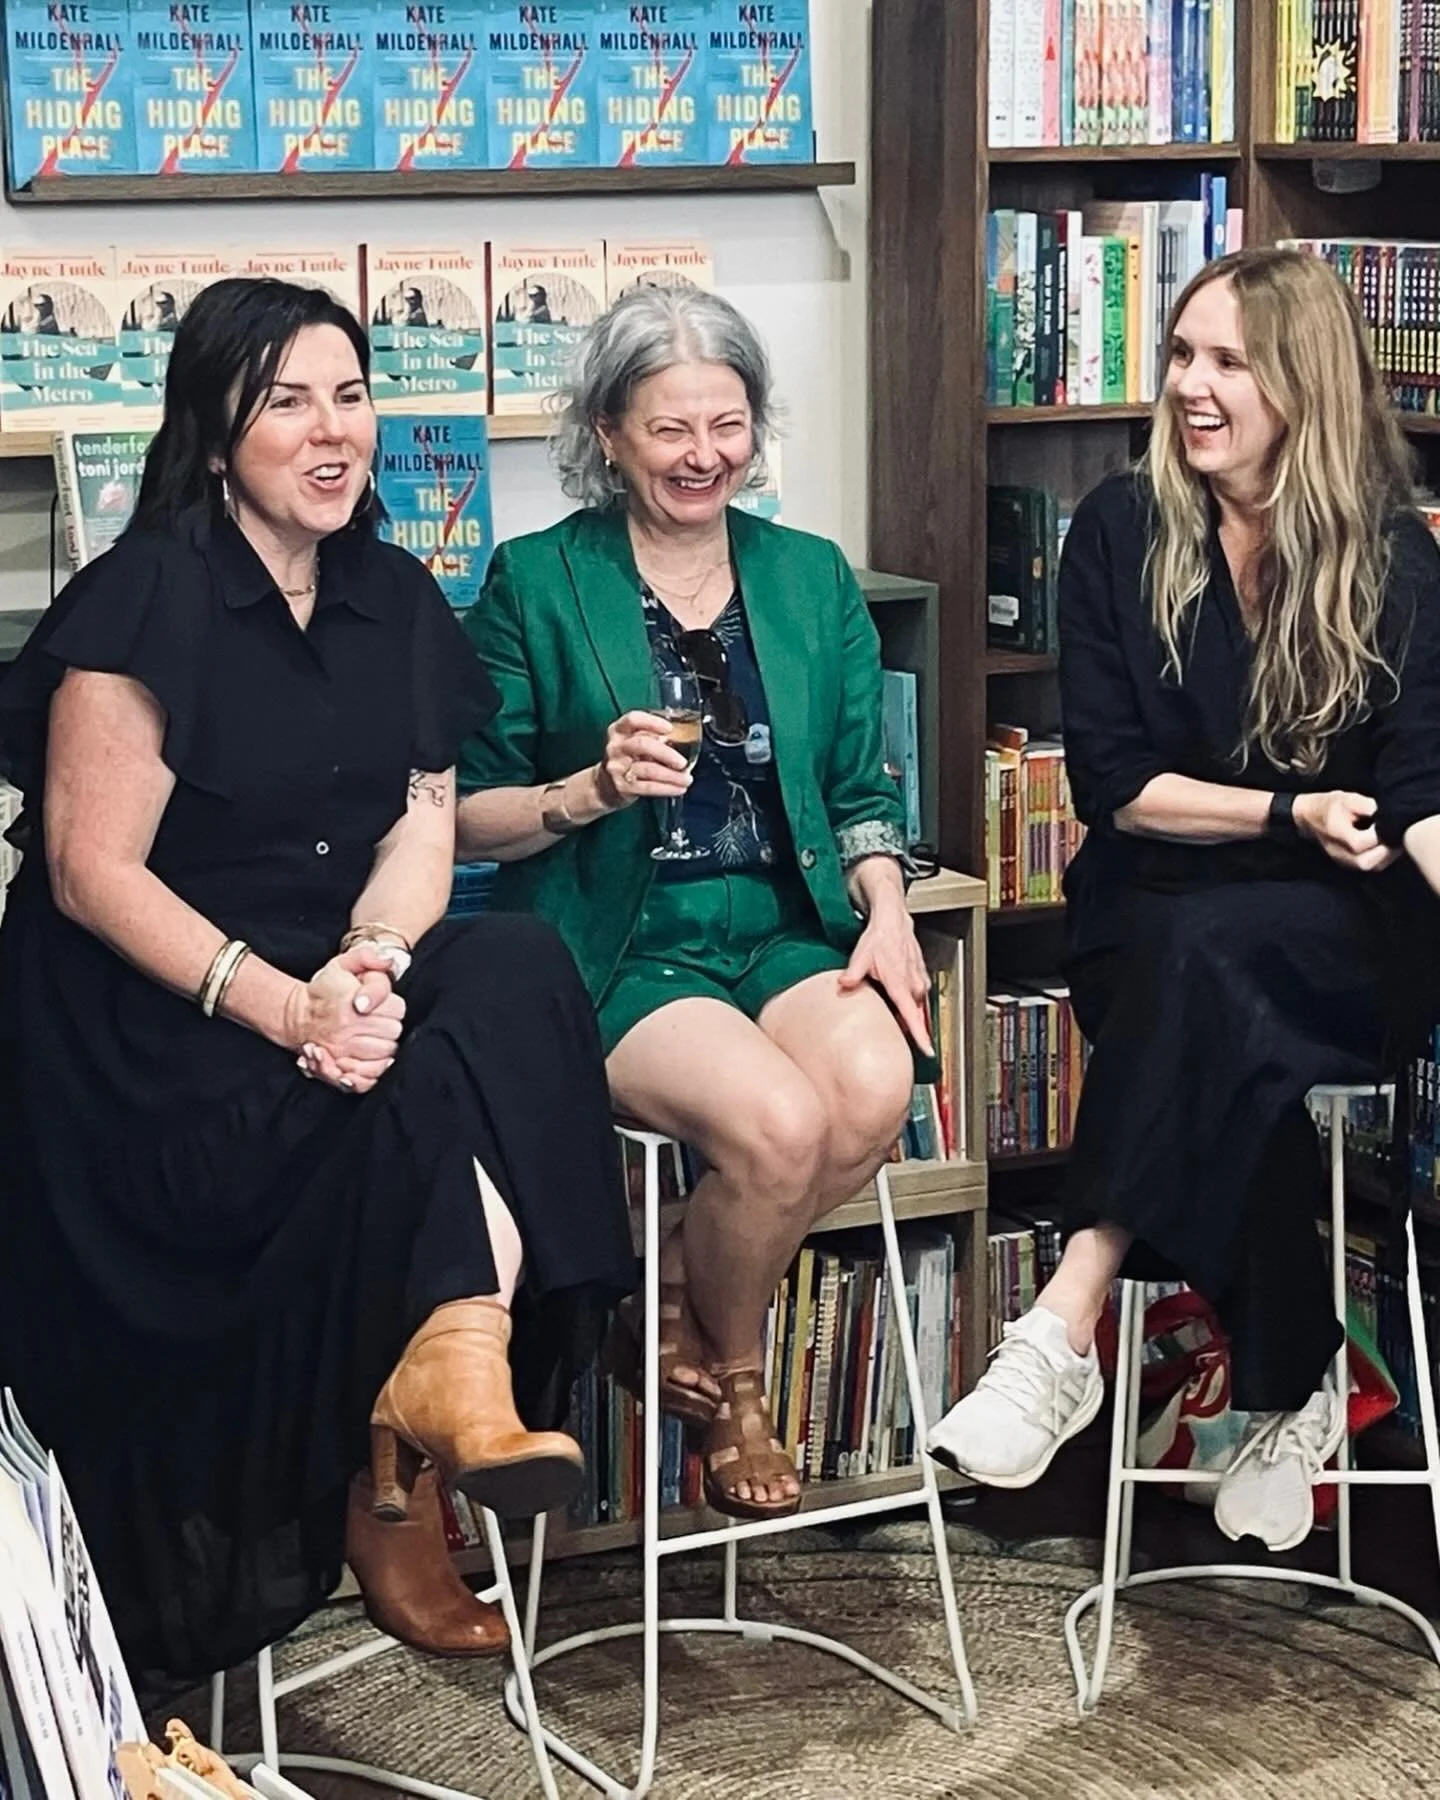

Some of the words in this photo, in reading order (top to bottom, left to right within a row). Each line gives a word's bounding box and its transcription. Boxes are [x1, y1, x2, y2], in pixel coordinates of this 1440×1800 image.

[48, 4, 89, 23] KATE
[170, 4, 210, 22] KATE
[291, 5, 331, 22] KATE
[406, 5, 445, 23] KATE
[519, 6, 557, 23] KATE
[630, 6, 668, 23] KATE
[739, 5, 775, 22] KATE
[16, 31, 124, 51] MILDENHALL
[138, 32, 244, 50] MILDENHALL
[260, 32, 364, 50] MILDENHALL
[376, 33, 478, 50] MILDENHALL
[490, 33, 589, 50] MILDENHALL
[600, 32, 698, 50] MILDENHALL
[710, 32, 805, 49] MILDENHALL
[52, 68, 94, 92] THE
[172, 67, 215, 91] THE
[294, 67, 335, 91] THE
[408, 67, 449, 91] THE
[521, 66, 561, 90] THE
[631, 65, 670, 89] THE
[741, 64, 777, 87] THE
[26, 99, 122, 129] HIDING
[147, 99, 241, 129] HIDING
[269, 98, 361, 127] HIDING
[384, 98, 475, 127] HIDING
[497, 97, 586, 125] HIDING
[608, 96, 695, 124] HIDING
[717, 95, 801, 122] HIDING
[1, 263, 50, 279] Jayne
[58, 261, 106, 277] Tuttle
[121, 260, 176, 278] Jayne
[180, 259, 230, 275] Tuttle
[243, 259, 294, 276] Jayne
[299, 257, 348, 273] Tuttle
[374, 258, 423, 274] Jayne
[427, 256, 474, 270] Tuttle
[498, 255, 546, 271] Jayne
[551, 254, 596, 269] Tuttle
[612, 253, 657, 269] Jayne
[391, 331, 427, 349] The
[429, 331, 464, 348] Sea
[512, 327, 551, 345] The
[19, 339, 59, 357] The
[61, 340, 98, 357] Sea
[403, 352, 422, 370] in
[427, 352, 457, 370] the
[33, 362, 54, 380] in
[59, 361, 91, 380] the
[523, 371, 570, 388] Met
[400, 375, 458, 393] Metro
[31, 386, 93, 403] Metro
[413, 425, 451, 443] KATE
[75, 435, 147, 457] tenderfo
[78, 458, 111, 477] toni
[113, 455, 147, 481] jord
[384, 453, 484, 472] MILDENHALL
[415, 488, 456, 512] THE
[393, 519, 481, 549] HIDING
